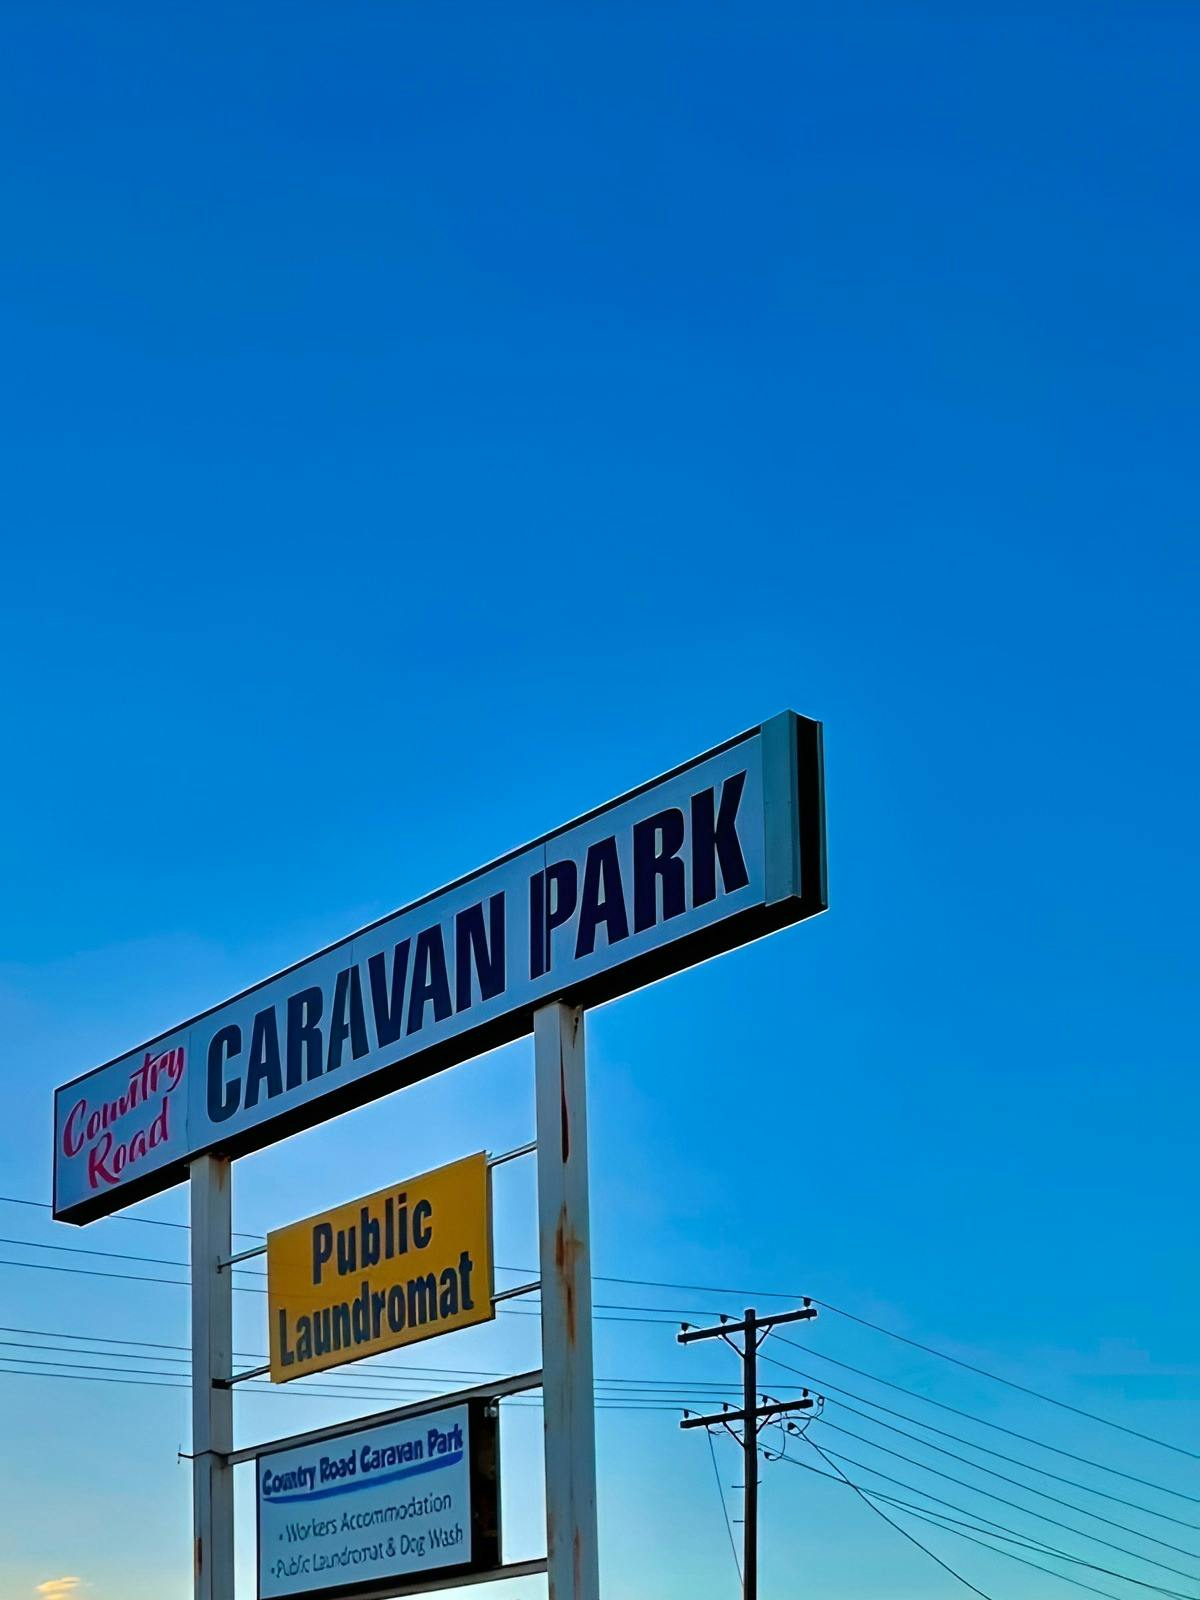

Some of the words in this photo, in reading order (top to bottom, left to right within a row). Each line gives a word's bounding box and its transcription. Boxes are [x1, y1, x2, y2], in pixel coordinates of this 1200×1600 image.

[206, 890, 506, 1124] CARAVAN
[529, 769, 751, 981] PARK
[63, 1046, 185, 1158] Country
[87, 1095, 169, 1189] Road
[312, 1192, 433, 1285] Public
[278, 1250, 475, 1367] Laundromat
[262, 1465, 316, 1495] Country
[319, 1450, 356, 1482] Road
[359, 1439, 424, 1473] Caravan
[426, 1423, 464, 1458] Park
[285, 1518, 338, 1543] Workers
[340, 1492, 453, 1532] Accommodation
[386, 1537, 397, 1557] &
[400, 1533, 426, 1557] Dog
[428, 1523, 464, 1550] Wash
